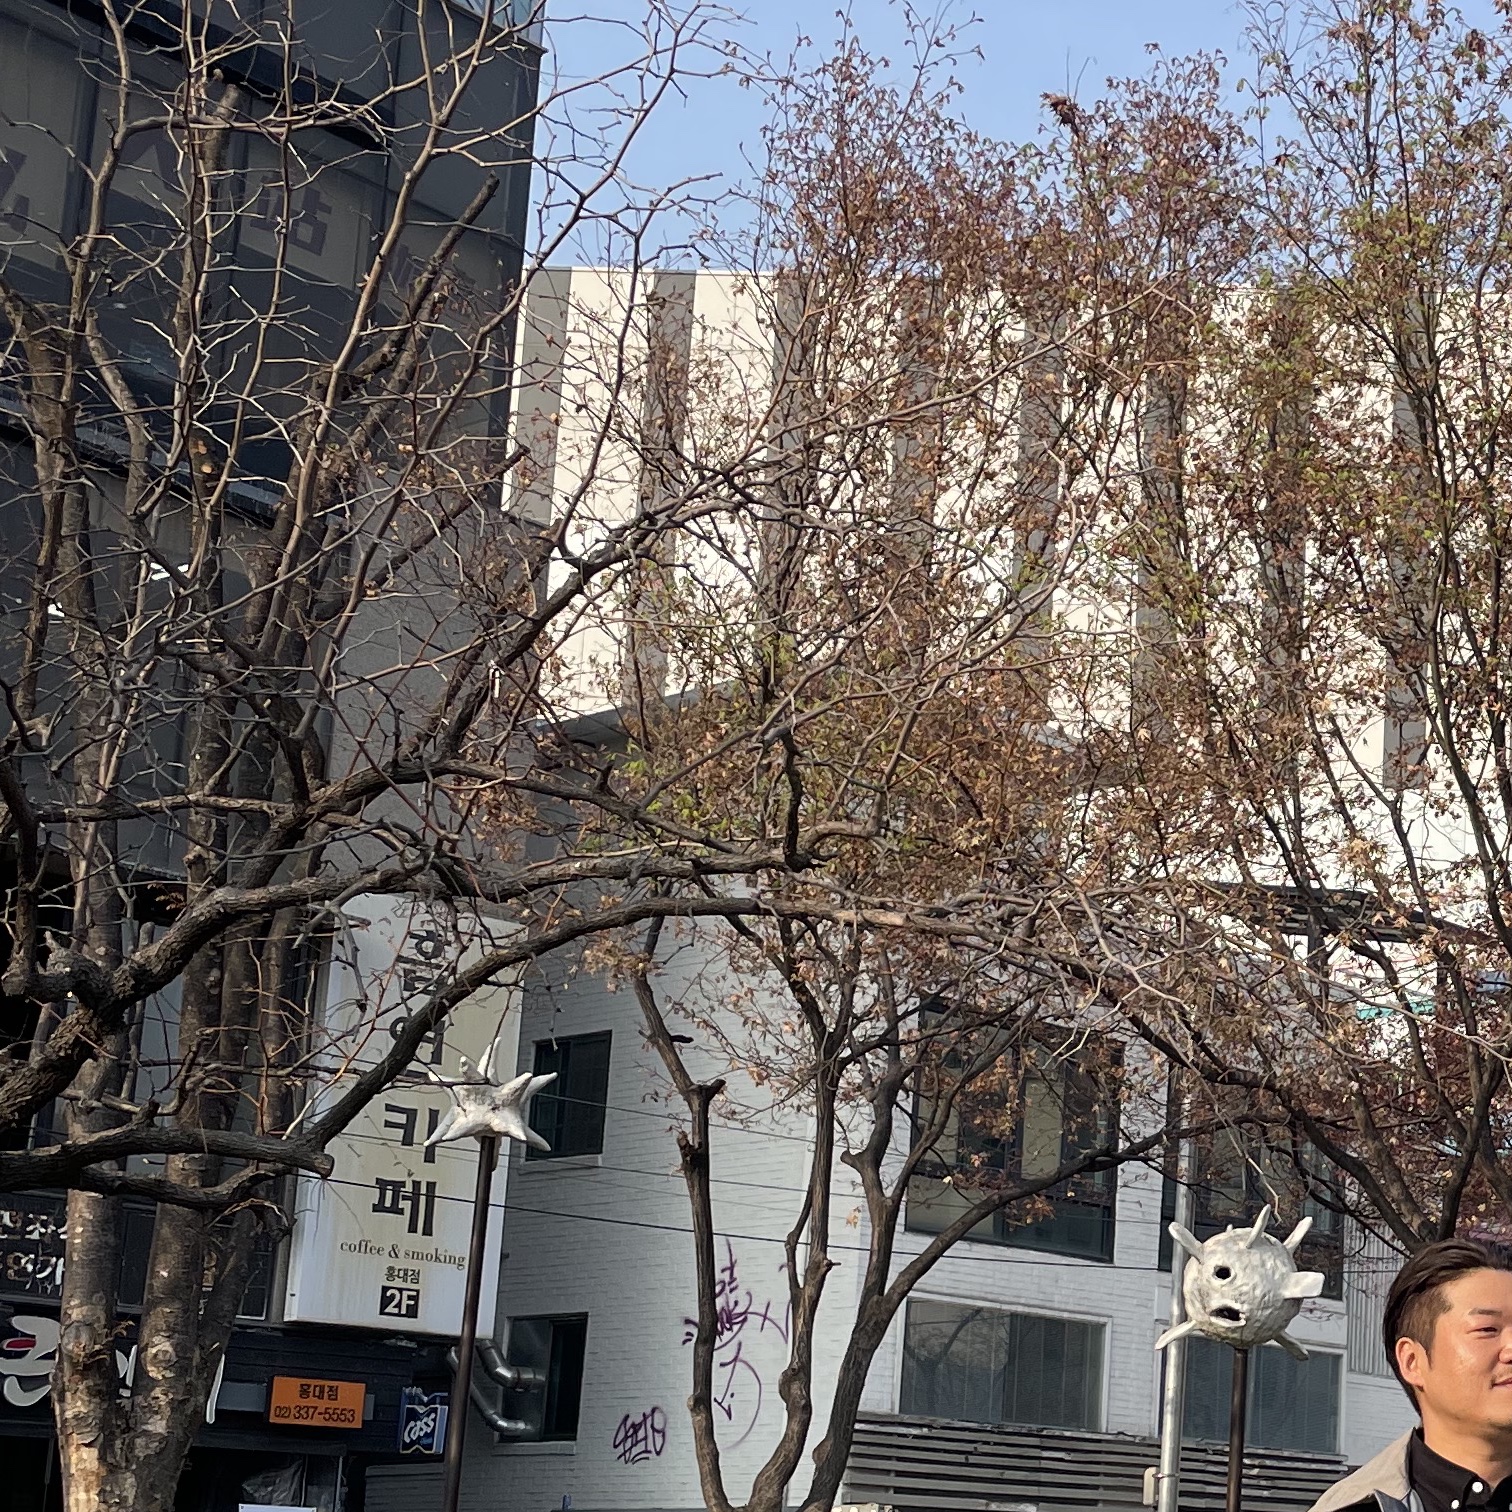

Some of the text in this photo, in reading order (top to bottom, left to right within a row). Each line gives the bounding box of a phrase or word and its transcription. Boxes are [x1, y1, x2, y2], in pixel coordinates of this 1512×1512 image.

[340, 1238, 466, 1271] coffee & smoking
[384, 1265, 421, 1285] 홍대점
[383, 1288, 418, 1316] 2F
[299, 1383, 340, 1402] 홍대점
